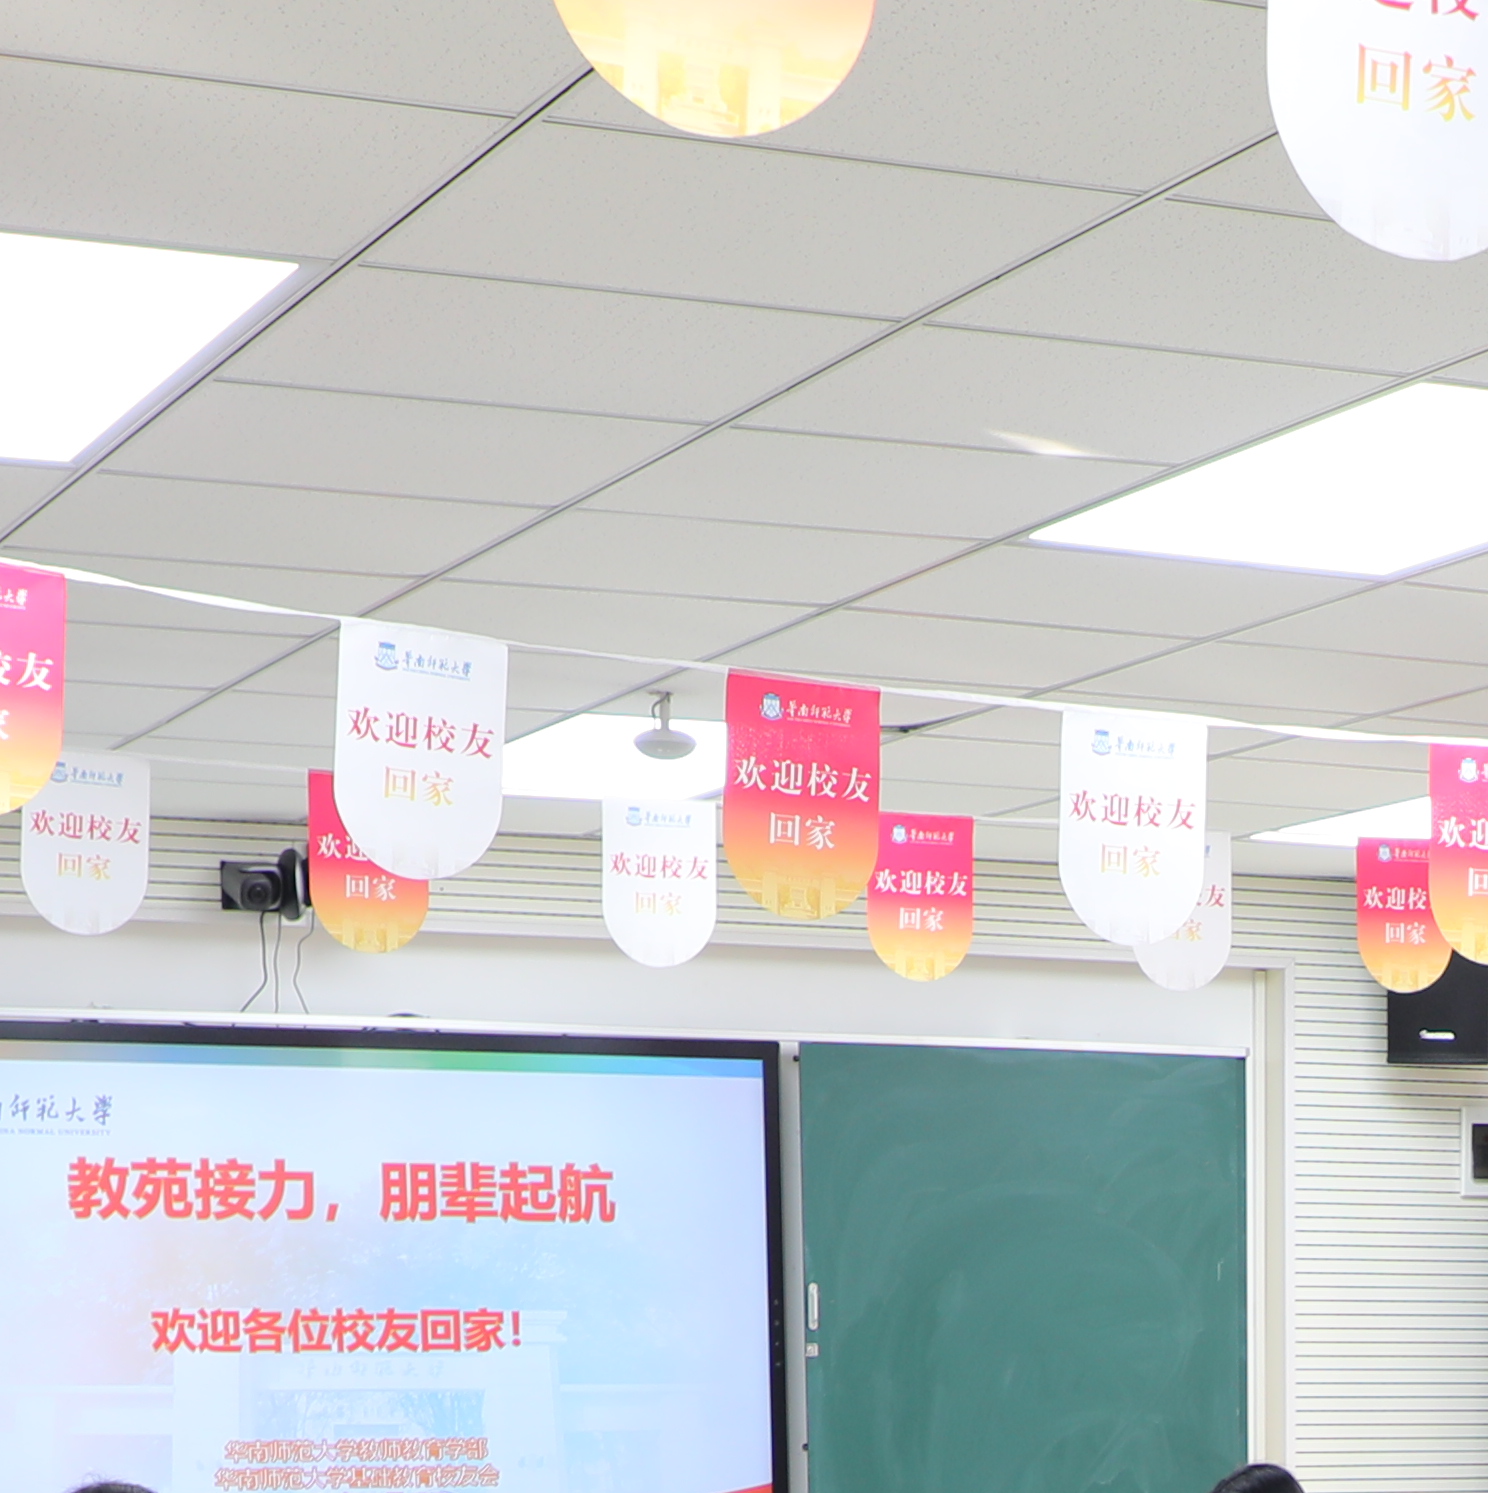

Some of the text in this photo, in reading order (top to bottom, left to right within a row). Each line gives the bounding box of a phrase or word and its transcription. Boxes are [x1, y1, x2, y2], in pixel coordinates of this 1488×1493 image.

[1357, 43, 1477, 122] 回家
[346, 706, 495, 759] 欢迎校友
[384, 766, 454, 807] 回家
[733, 756, 872, 802] 欢迎校友
[1068, 789, 1196, 830] 欢迎校友
[30, 810, 142, 844] 欢迎校友
[768, 812, 835, 850] 回家
[57, 852, 111, 880] 回家
[609, 852, 709, 881] 欢迎校友
[1100, 843, 1161, 878] 回家
[345, 874, 396, 901] 回家
[874, 868, 968, 897] 欢迎校友
[1363, 886, 1429, 912] 欢迎校
[898, 907, 944, 932] 回家
[1385, 922, 1426, 946] 回家
[18, 1127, 56, 1136] NORMAL
[58, 1128, 111, 1137] UNIVERSITY
[68, 1157, 617, 1226] 教苑接力，朋辈起航
[224, 1438, 490, 1464] 华南师范大学教师教育学部
[214, 1464, 501, 1491] 华南师范大学基础教育校友会
